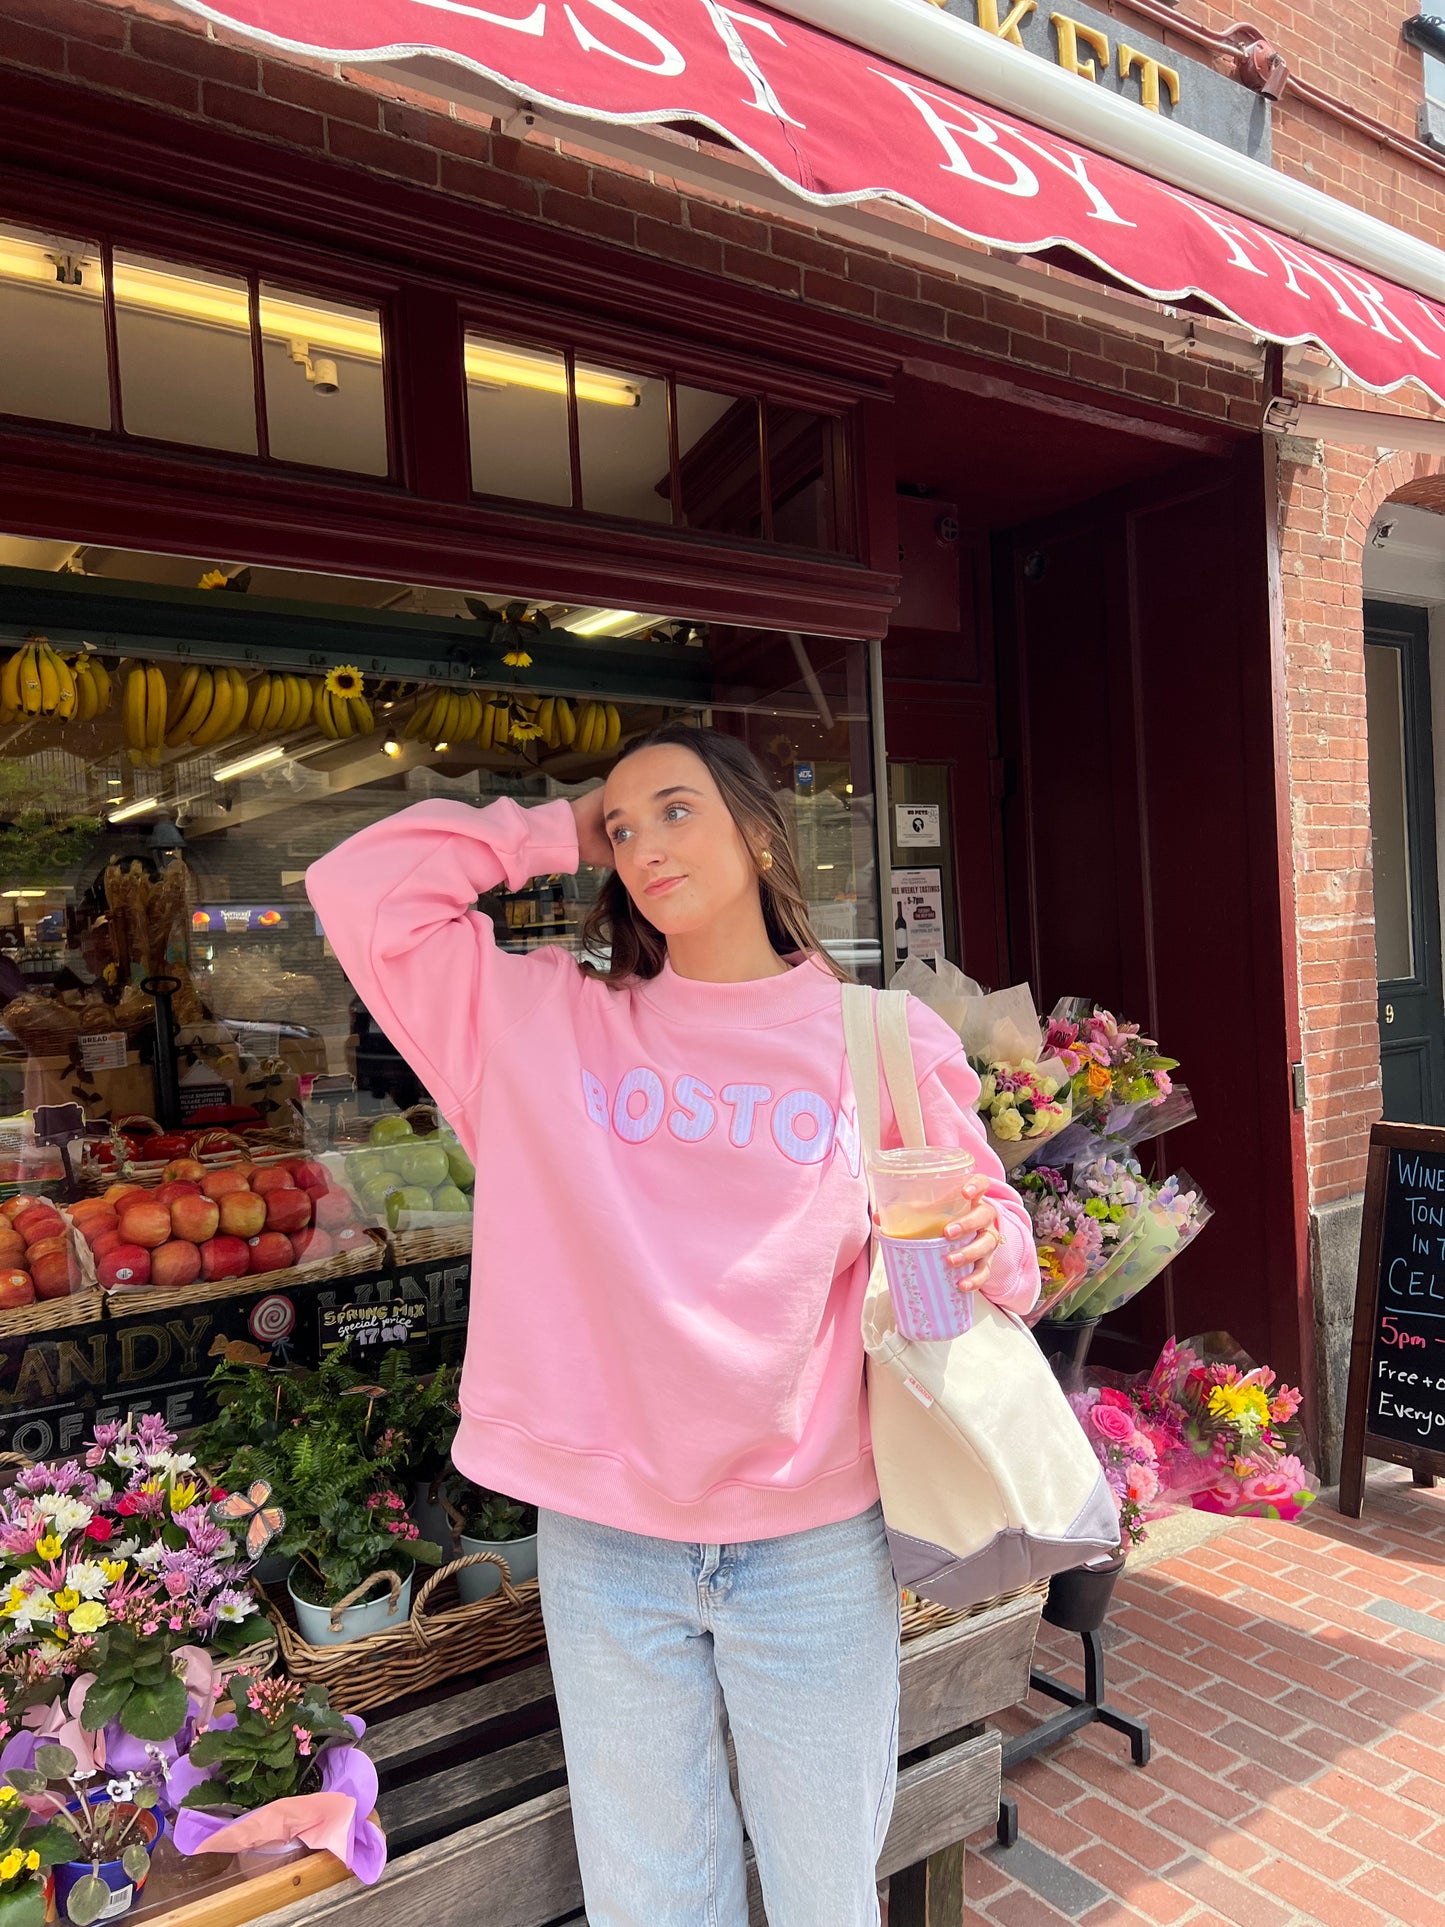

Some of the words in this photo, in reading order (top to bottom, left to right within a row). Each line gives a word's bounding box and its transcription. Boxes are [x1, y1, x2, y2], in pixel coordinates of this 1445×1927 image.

[925, 0, 1180, 114] KET
[866, 66, 1138, 228] BY
[1152, 184, 1441, 360] FAR
[1386, 1003, 1394, 1024] 9
[582, 1065, 861, 1178] BOSTON
[1412, 1233, 1429, 1255] IN
[323, 1305, 388, 1326] SPRING
[392, 1303, 425, 1319] MIX
[381, 1316, 414, 1329] price
[1380, 1316, 1426, 1349] 5pm
[0, 1315, 213, 1397] ANDY
[1378, 1360, 1418, 1386] Free
